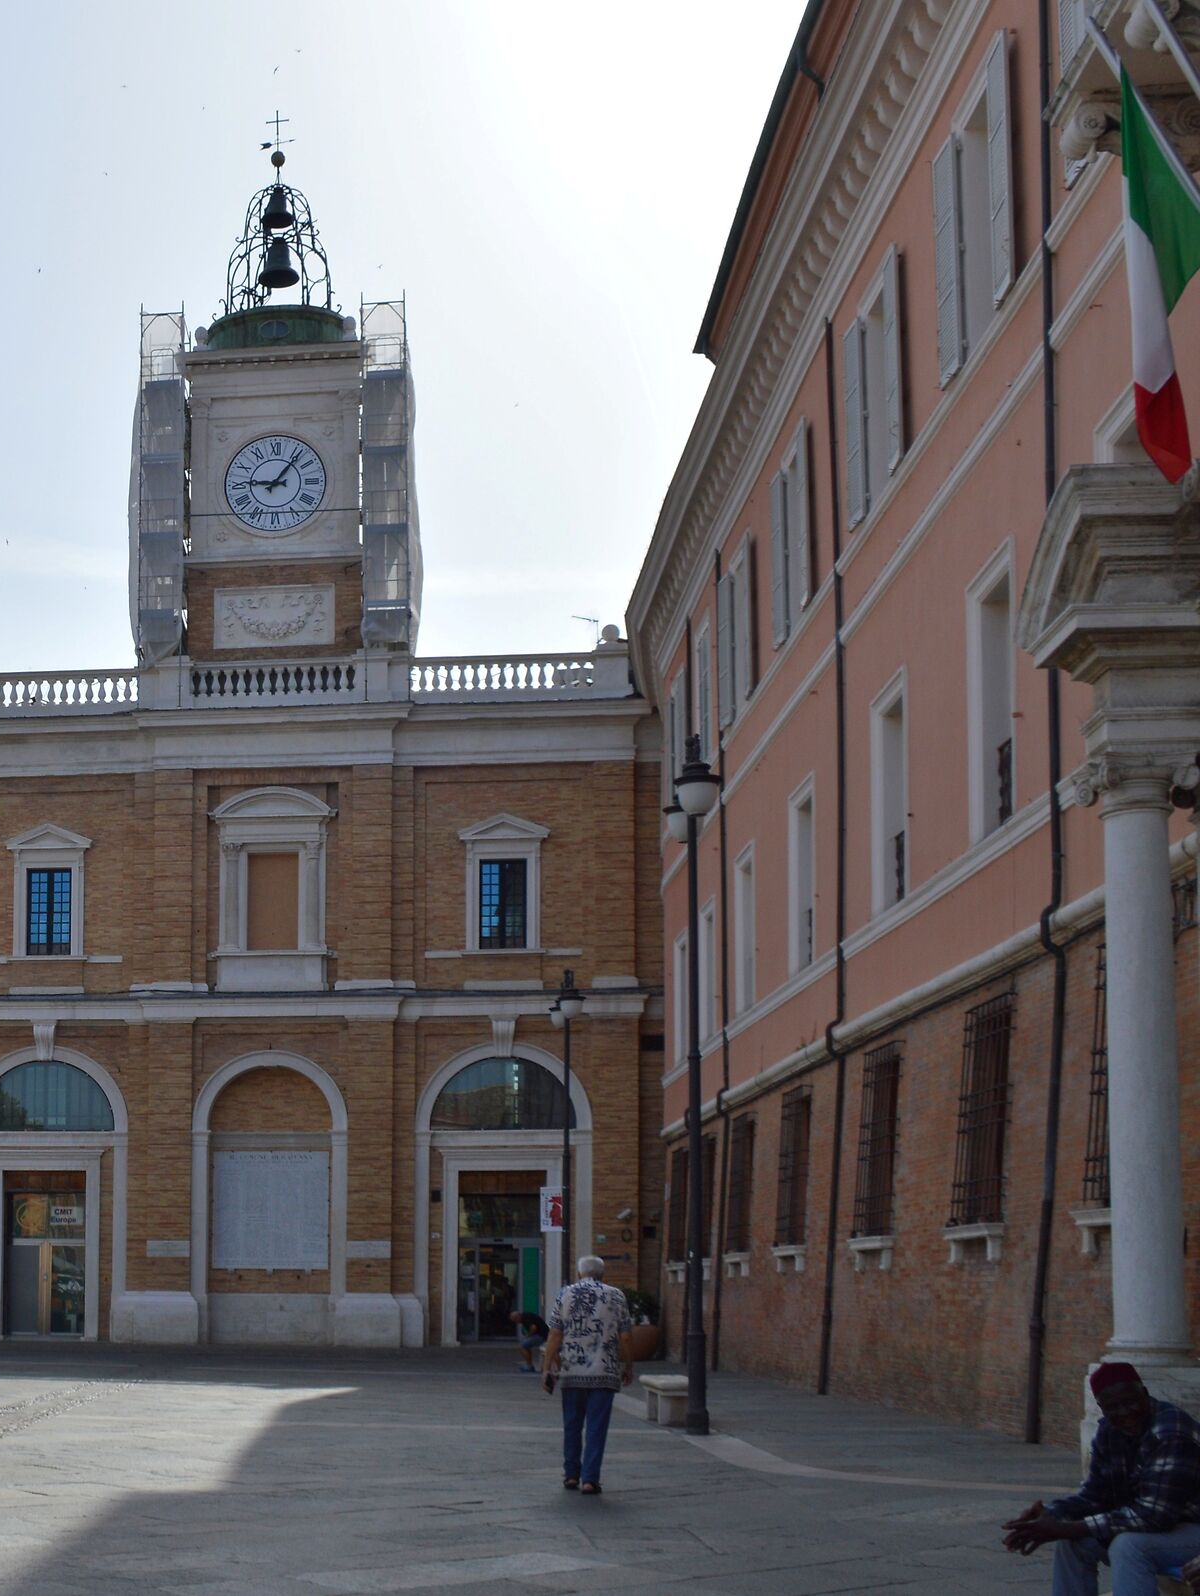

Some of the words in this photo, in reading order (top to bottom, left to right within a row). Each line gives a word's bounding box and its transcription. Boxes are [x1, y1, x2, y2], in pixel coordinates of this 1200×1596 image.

[251, 447, 265, 462] XI
[270, 442, 281, 456] XII
[236, 463, 252, 473] X
[300, 460, 314, 470] II
[235, 494, 252, 511] VIII
[54, 1208, 73, 1216] CMIT
